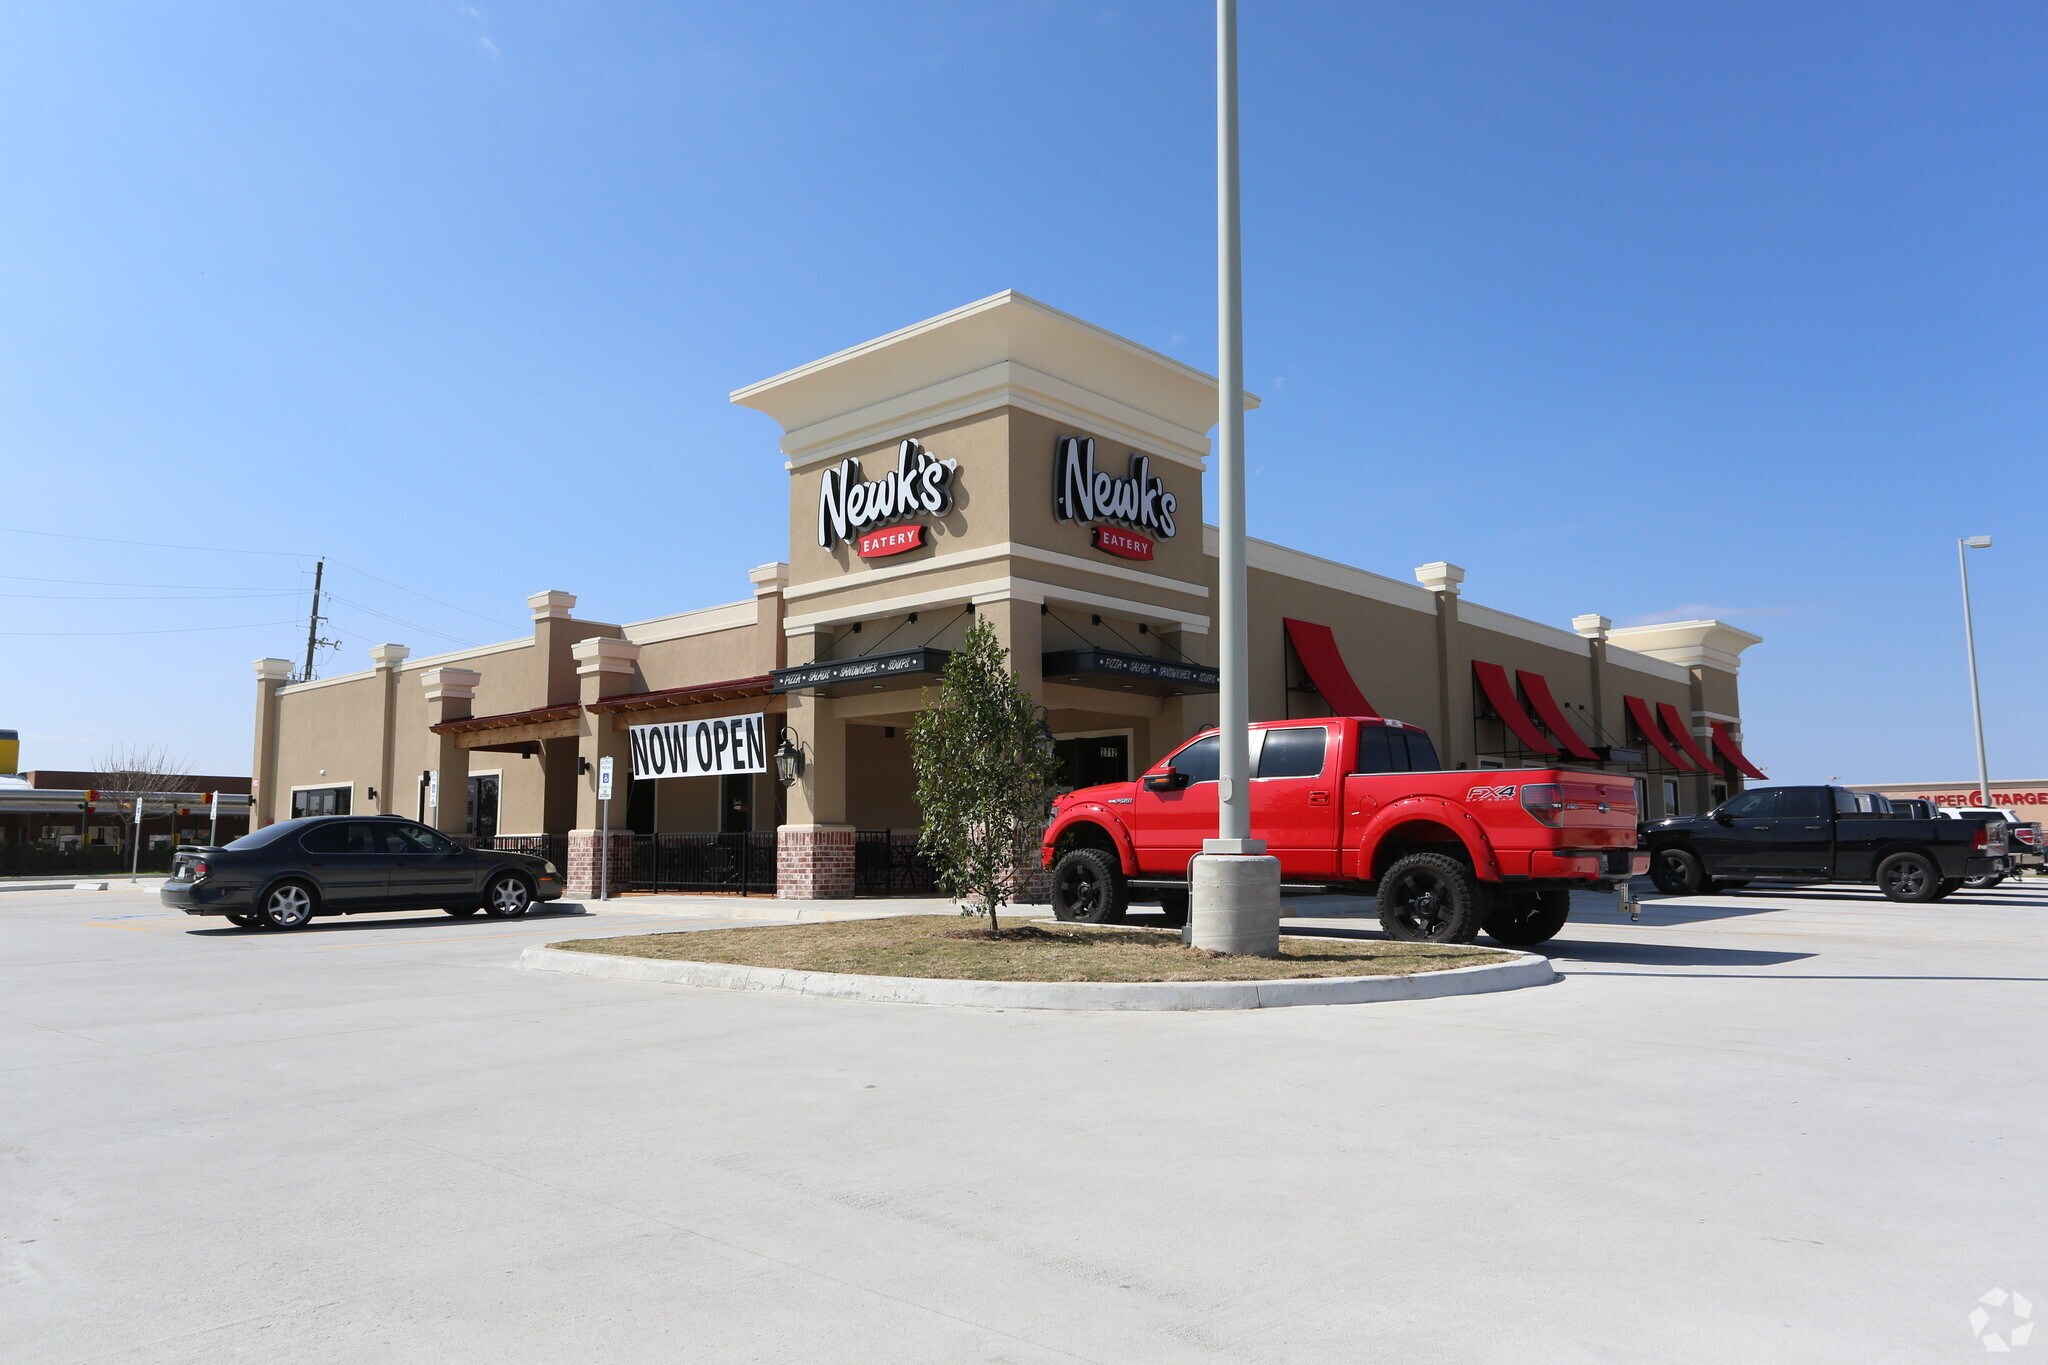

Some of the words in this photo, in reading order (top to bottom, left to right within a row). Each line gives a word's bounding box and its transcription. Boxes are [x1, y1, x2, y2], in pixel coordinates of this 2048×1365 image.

[818, 439, 943, 547] Newk's
[1065, 437, 1177, 538] Newk's
[863, 529, 915, 552] EATERY
[1103, 532, 1149, 554] EATERY
[784, 674, 801, 685] PIZZA
[808, 669, 831, 681] SALADS
[839, 662, 878, 677] SANDWICHES
[887, 657, 911, 670] SOUPS
[1105, 658, 1122, 669] PIZZA
[1129, 662, 1151, 674] SALADS
[1158, 666, 1191, 680] SANDWICHES
[1199, 672, 1217, 683] SOUPS
[631, 724, 689, 776] NOW
[696, 716, 764, 772] OPEN
[1466, 785, 1517, 799] FX4
[1991, 793, 2048, 806] TARGE
